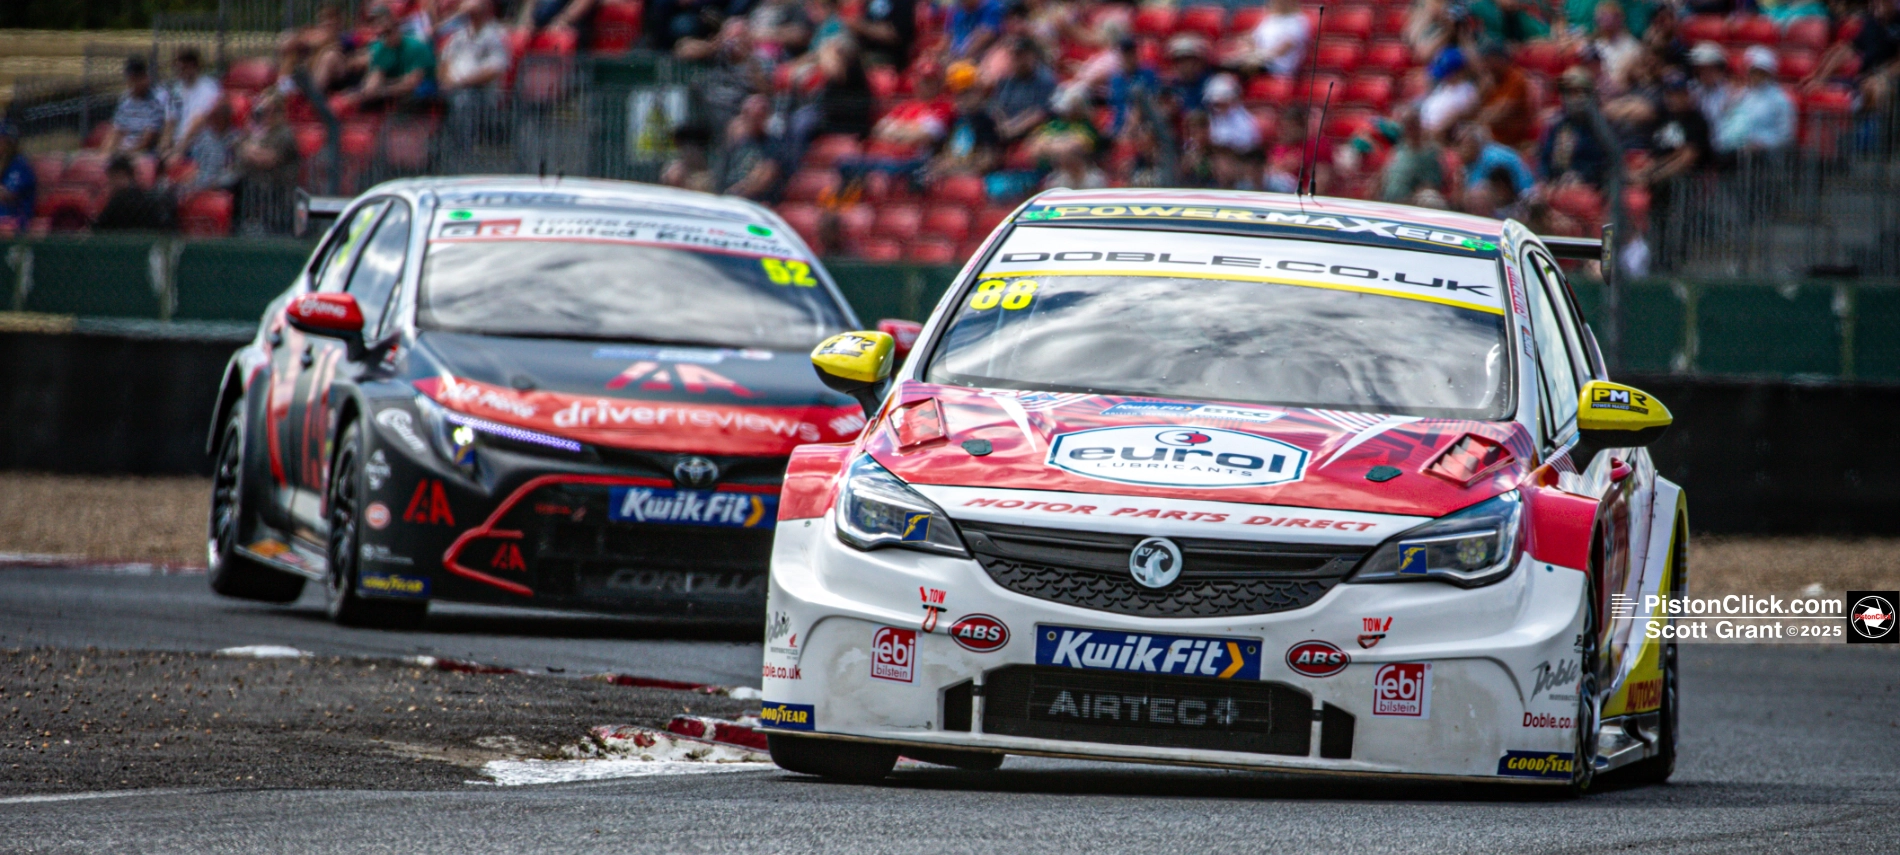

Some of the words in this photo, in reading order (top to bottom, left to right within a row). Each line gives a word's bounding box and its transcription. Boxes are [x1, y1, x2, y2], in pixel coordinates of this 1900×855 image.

[1055, 206, 1253, 221] POWER
[762, 257, 817, 287] 52
[1000, 251, 1495, 297] DOBLE.CO.UK
[970, 280, 1037, 309] 88
[1594, 389, 1647, 406] PMR
[553, 400, 822, 442] driverreviews
[1068, 446, 1287, 474] eurol
[1096, 462, 1253, 477] LUBRICANTS
[964, 497, 1098, 516] MOTOR
[1110, 507, 1230, 524] PARTS
[1243, 515, 1377, 533] DIRECT
[929, 588, 947, 604] TOW
[959, 624, 1001, 642] ABS
[1362, 617, 1382, 632] TOW
[871, 629, 915, 665] febi
[1296, 650, 1343, 665] ABS
[876, 664, 907, 679] bilstein
[1374, 665, 1423, 699] febi
[1530, 658, 1579, 702] Doble
[1049, 690, 1208, 725] AIRTEC
[1379, 701, 1416, 713] bilstein
